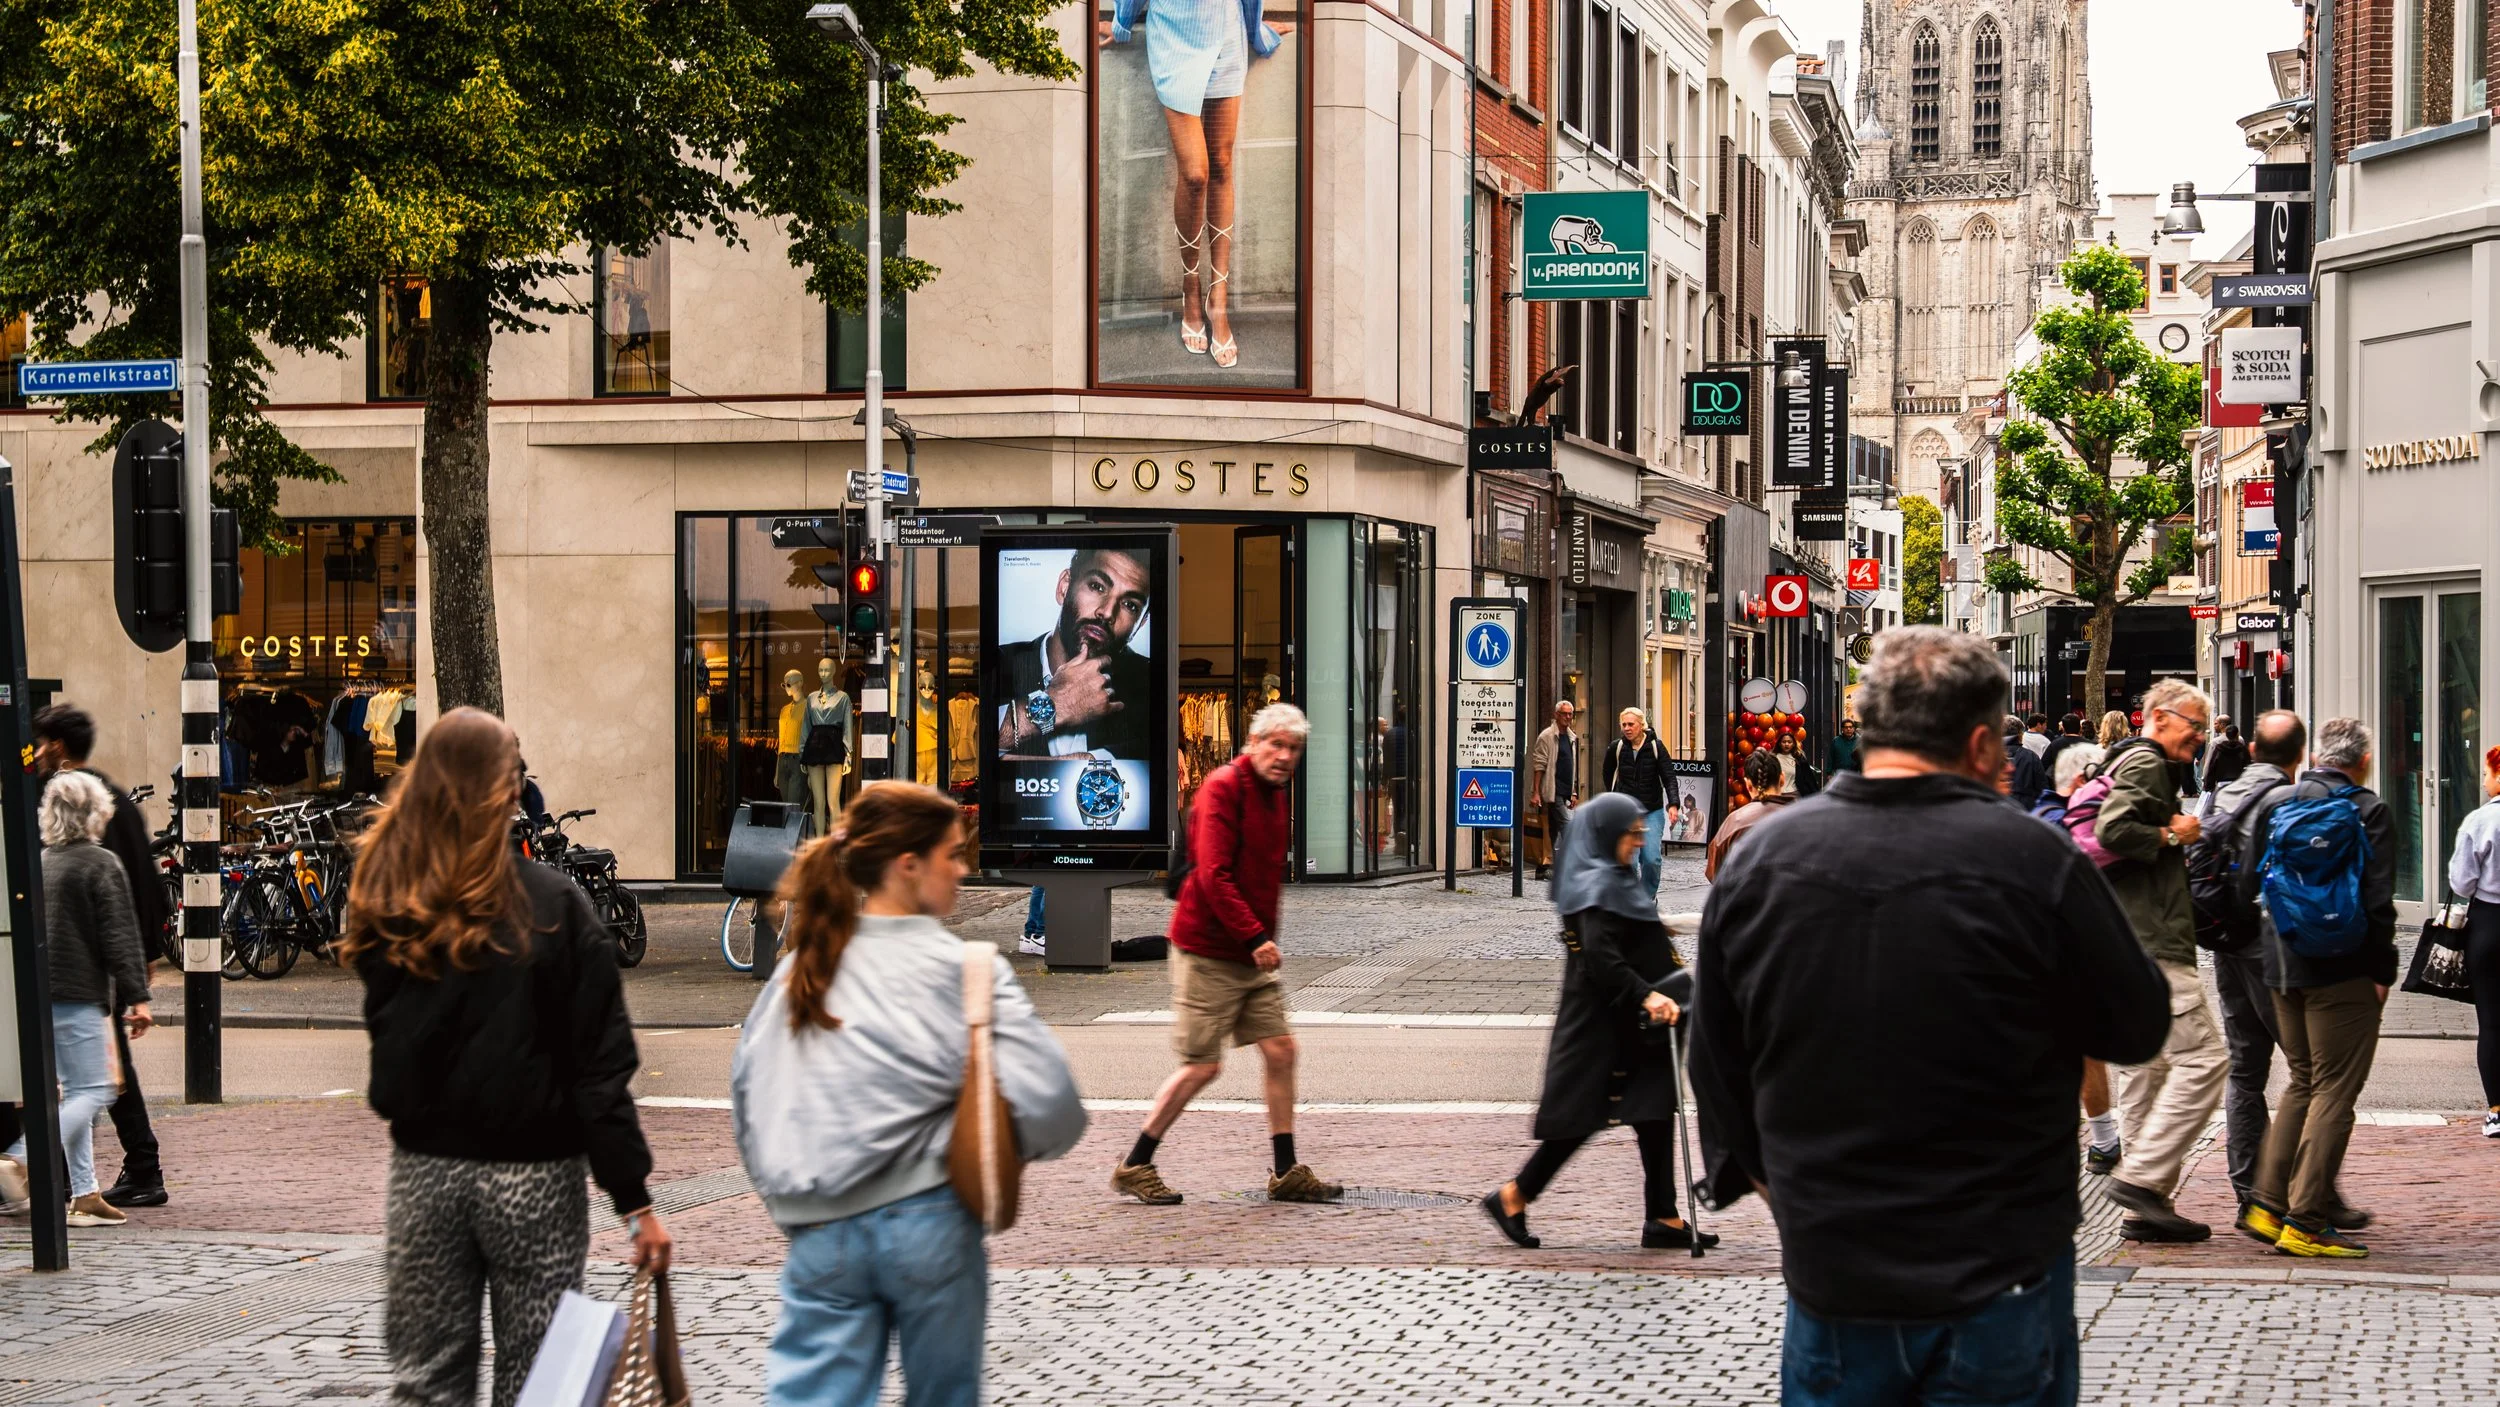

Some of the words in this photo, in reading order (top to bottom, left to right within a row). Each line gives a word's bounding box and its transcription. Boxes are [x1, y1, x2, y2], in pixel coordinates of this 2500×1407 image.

[2238, 284, 2306, 297] SWAROVSKI
[2232, 350, 2290, 361] SCOTCH
[2232, 363, 2245, 374] &
[2249, 362, 2290, 373] SODA
[28, 367, 170, 385] Karnemelkstraat
[1692, 415, 1742, 425] DOUGLAS
[1788, 409, 1810, 468] DENIM
[1478, 442, 1546, 454] COSTES
[1092, 457, 1310, 496] COSTES
[1802, 513, 1843, 522] SAMSUNG
[786, 520, 811, 528] Q-Park
[900, 527, 945, 535] Stadskantoor
[900, 536, 925, 544] Chassé
[926, 536, 952, 544] Theater
[1573, 516, 1585, 584] MANFIELD
[2238, 615, 2276, 628] Gabor
[240, 635, 370, 657] COSTES
[1461, 700, 1513, 709] toegestaan
[1015, 778, 1060, 793] BOSS
[1463, 804, 1508, 813] Doorrijden
[1468, 813, 1476, 821] is
[1478, 813, 1502, 821] boete
[1053, 856, 1094, 864] JCDecaux
